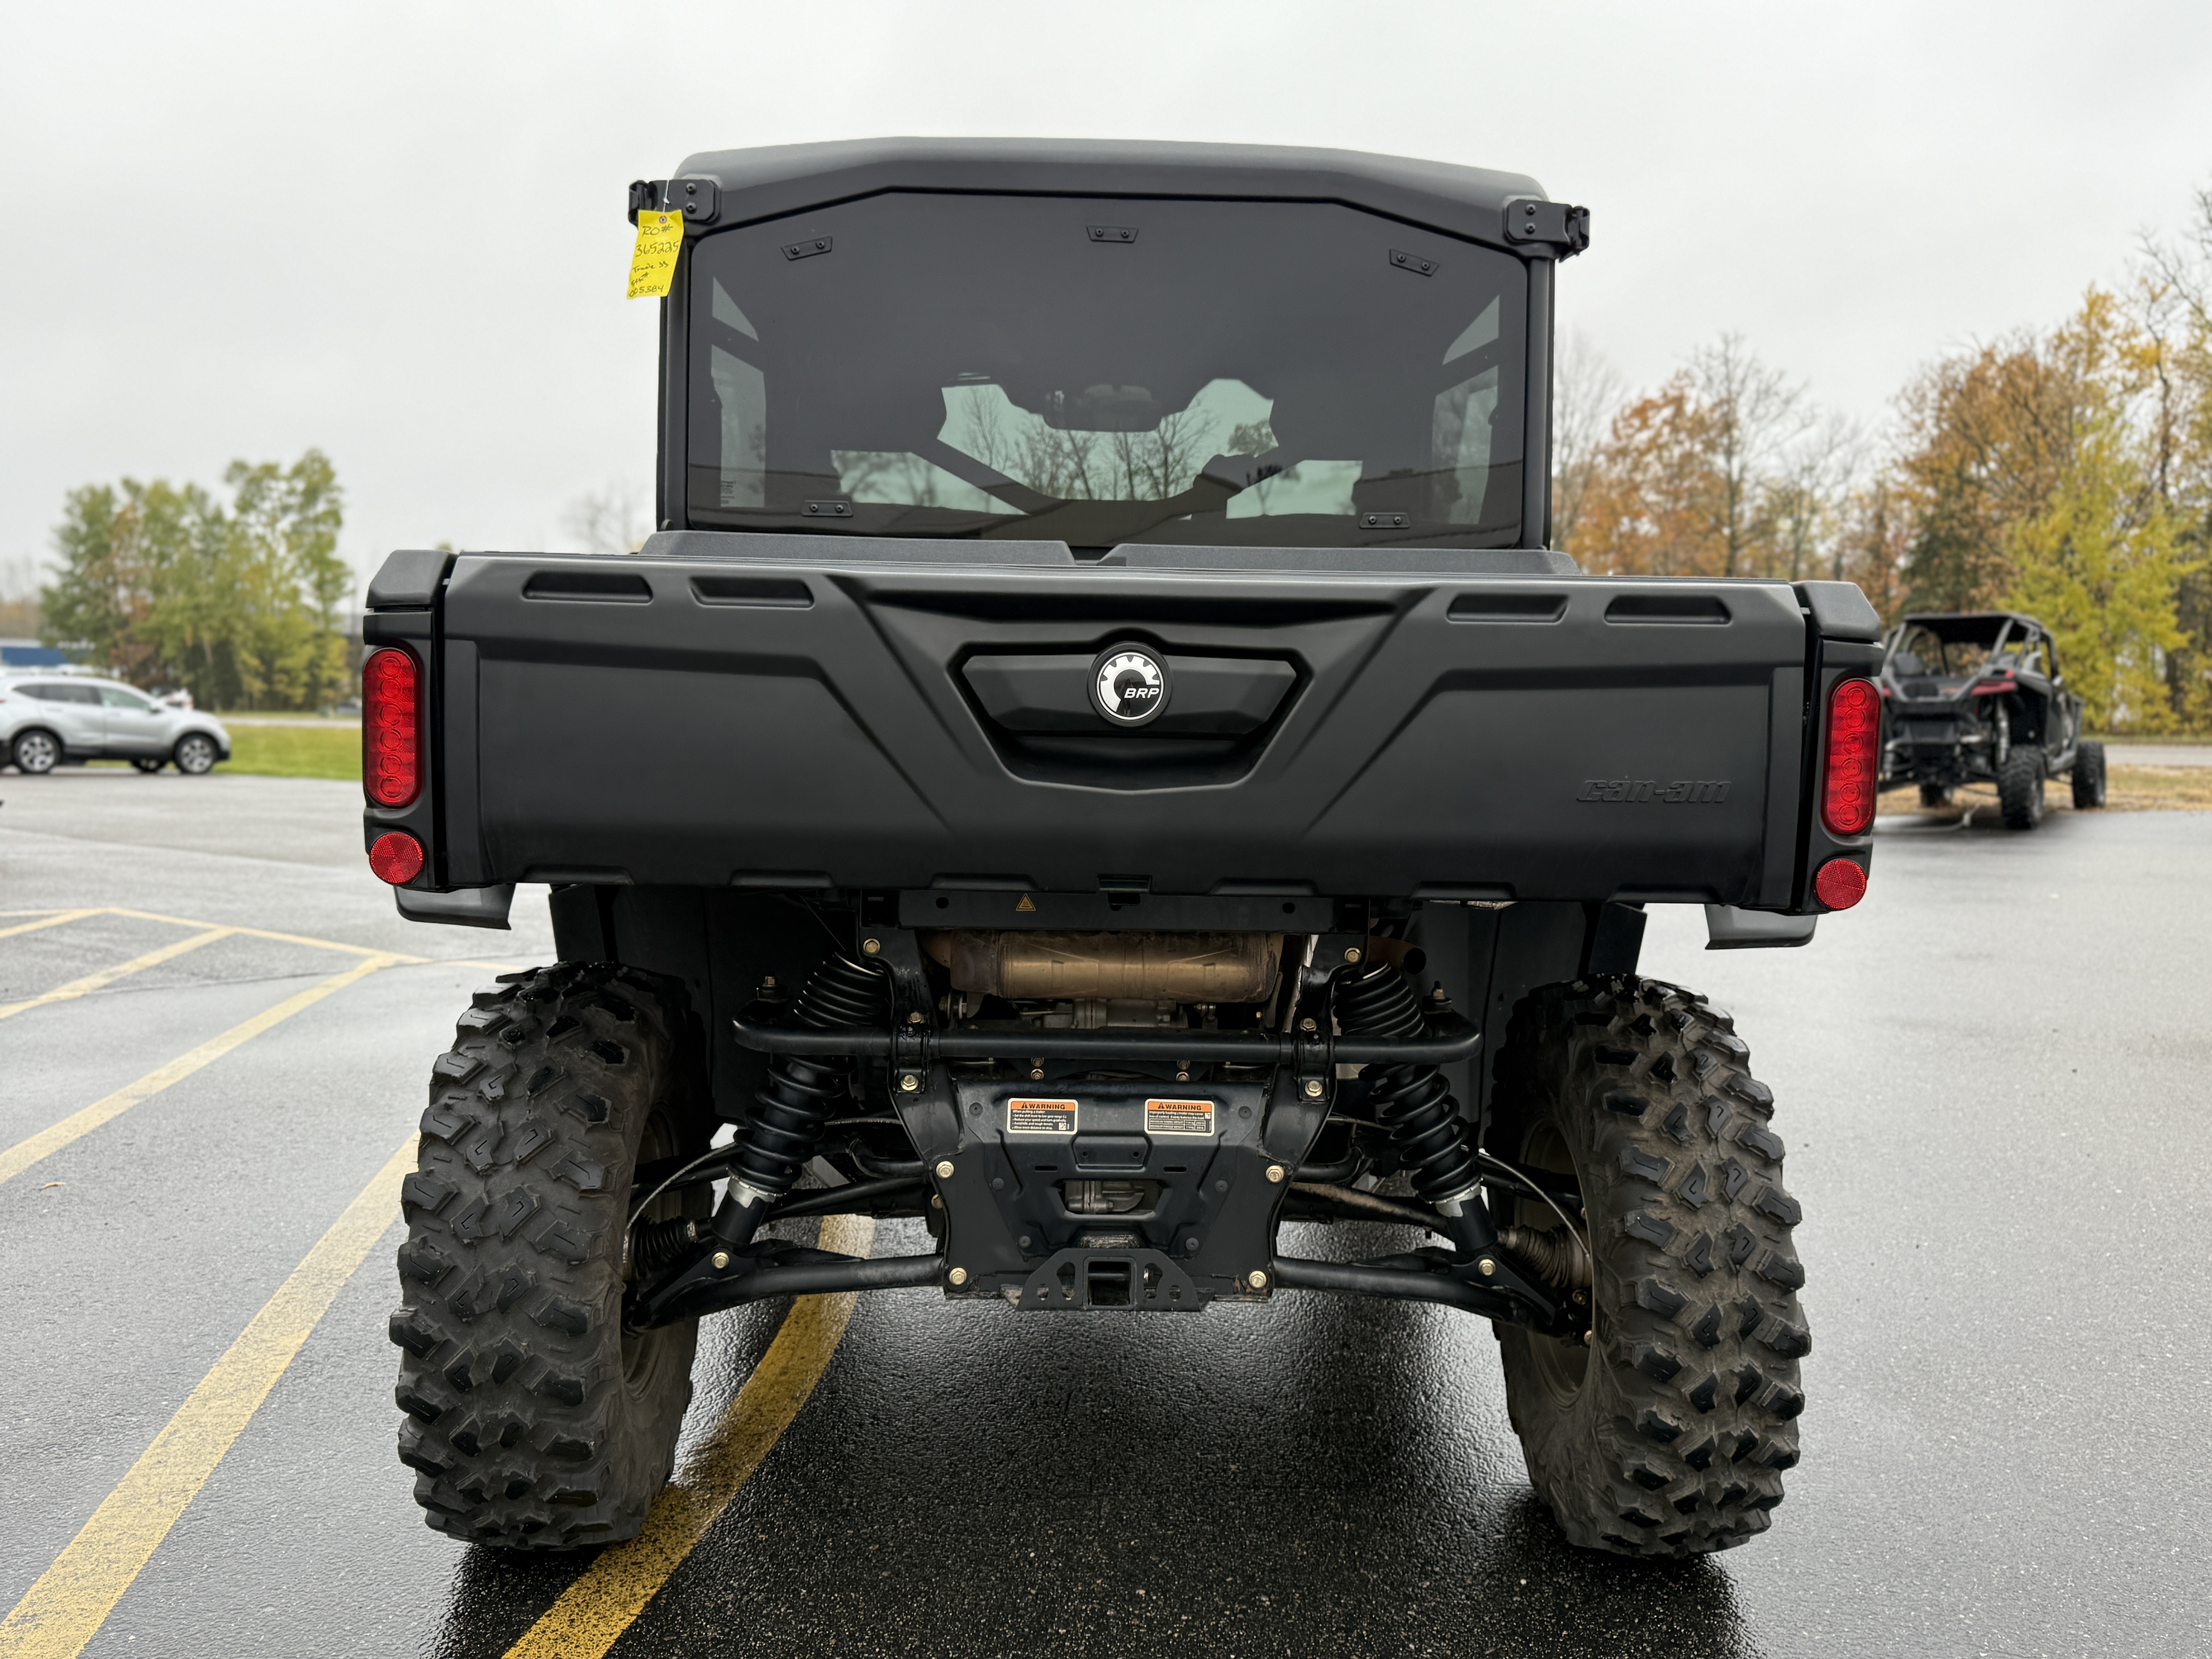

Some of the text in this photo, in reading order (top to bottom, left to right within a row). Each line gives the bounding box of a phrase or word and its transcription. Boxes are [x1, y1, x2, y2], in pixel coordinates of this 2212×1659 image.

[635, 240, 680, 258] 365225
[1124, 688, 1159, 698] BRP
[1576, 780, 1731, 803] can-am
